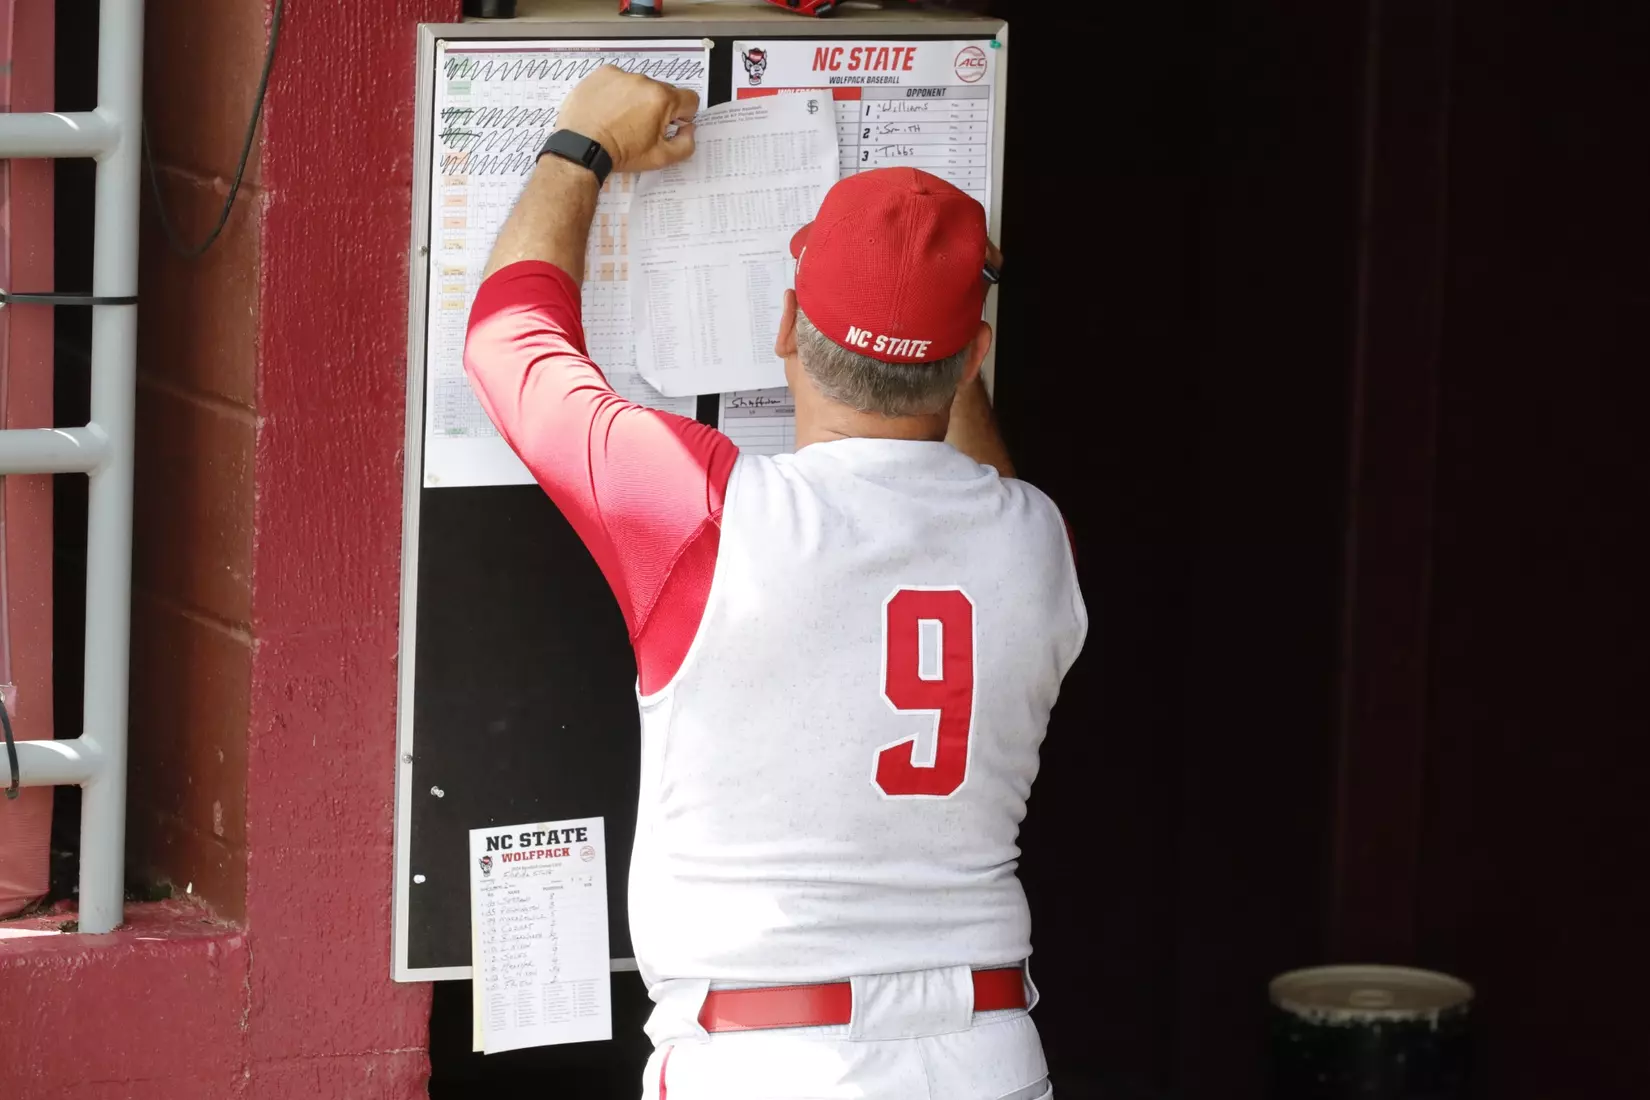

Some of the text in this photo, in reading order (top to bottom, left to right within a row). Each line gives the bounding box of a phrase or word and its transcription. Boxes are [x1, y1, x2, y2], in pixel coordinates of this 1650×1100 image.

[812, 47, 917, 71] NC STATE
[958, 57, 986, 67] ACC
[829, 75, 900, 84] WOLFPACK BASEBALL
[906, 88, 946, 97] OPPONENT
[865, 105, 871, 116] 1
[862, 128, 871, 139] 2
[861, 151, 869, 161] 3
[845, 326, 932, 358] NC STATE
[870, 585, 978, 799] 9
[486, 827, 588, 851] NC STATE
[502, 847, 570, 863] WOLFPACK
